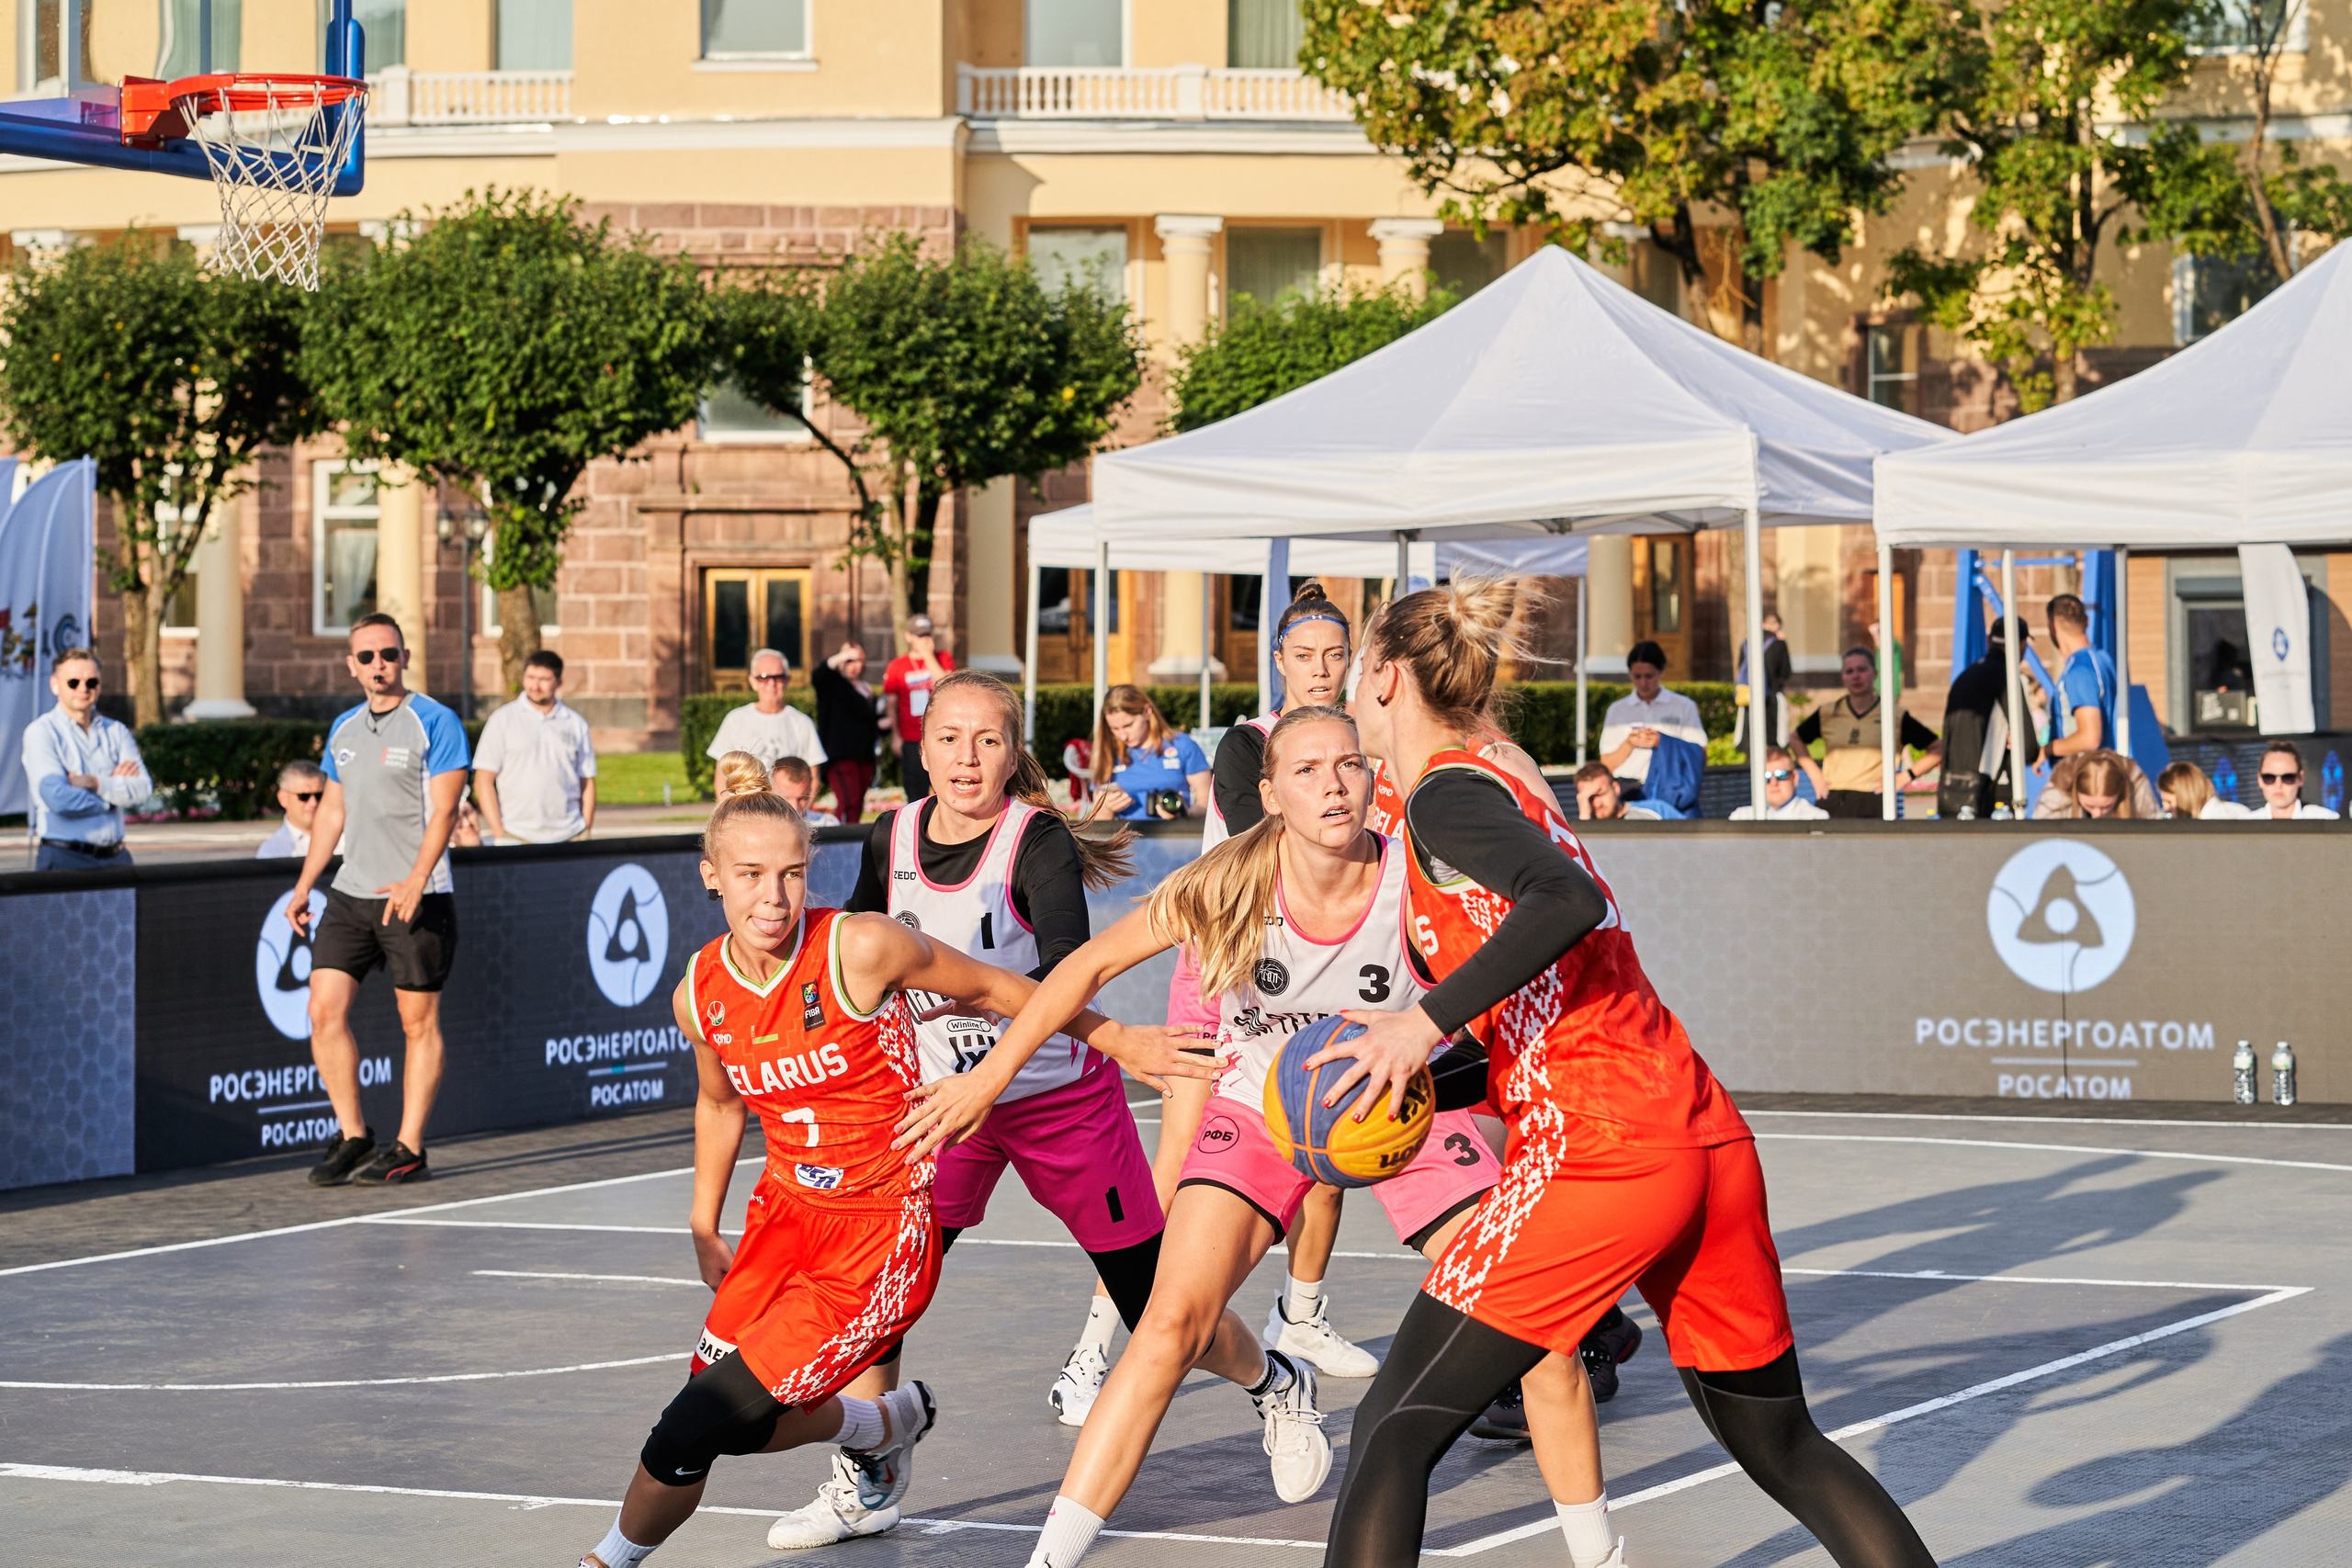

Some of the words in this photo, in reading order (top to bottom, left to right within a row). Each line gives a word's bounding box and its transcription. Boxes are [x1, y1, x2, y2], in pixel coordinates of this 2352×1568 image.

[981, 912, 995, 949] 1
[1359, 964, 1390, 1003] 3
[805, 1006, 820, 1019] FIBA
[951, 1021, 980, 1029] Winline
[546, 1025, 694, 1066] РОСЭНЕРГОАТО
[1916, 1017, 2215, 1050] РОСЭНЕРГОАТОМ
[209, 1056, 392, 1103] РОСЭНЕРГОМ
[721, 1043, 849, 1096] ELARUS
[591, 1078, 665, 1107] РОСАТОМ
[1997, 1074, 2132, 1100] РОСАТОМ
[781, 1107, 820, 1147] 7
[1203, 1130, 1234, 1142] РФБ
[1444, 1133, 1481, 1166] 3
[1105, 1186, 1125, 1223] 1
[699, 1337, 729, 1360] ЭЛЕ
